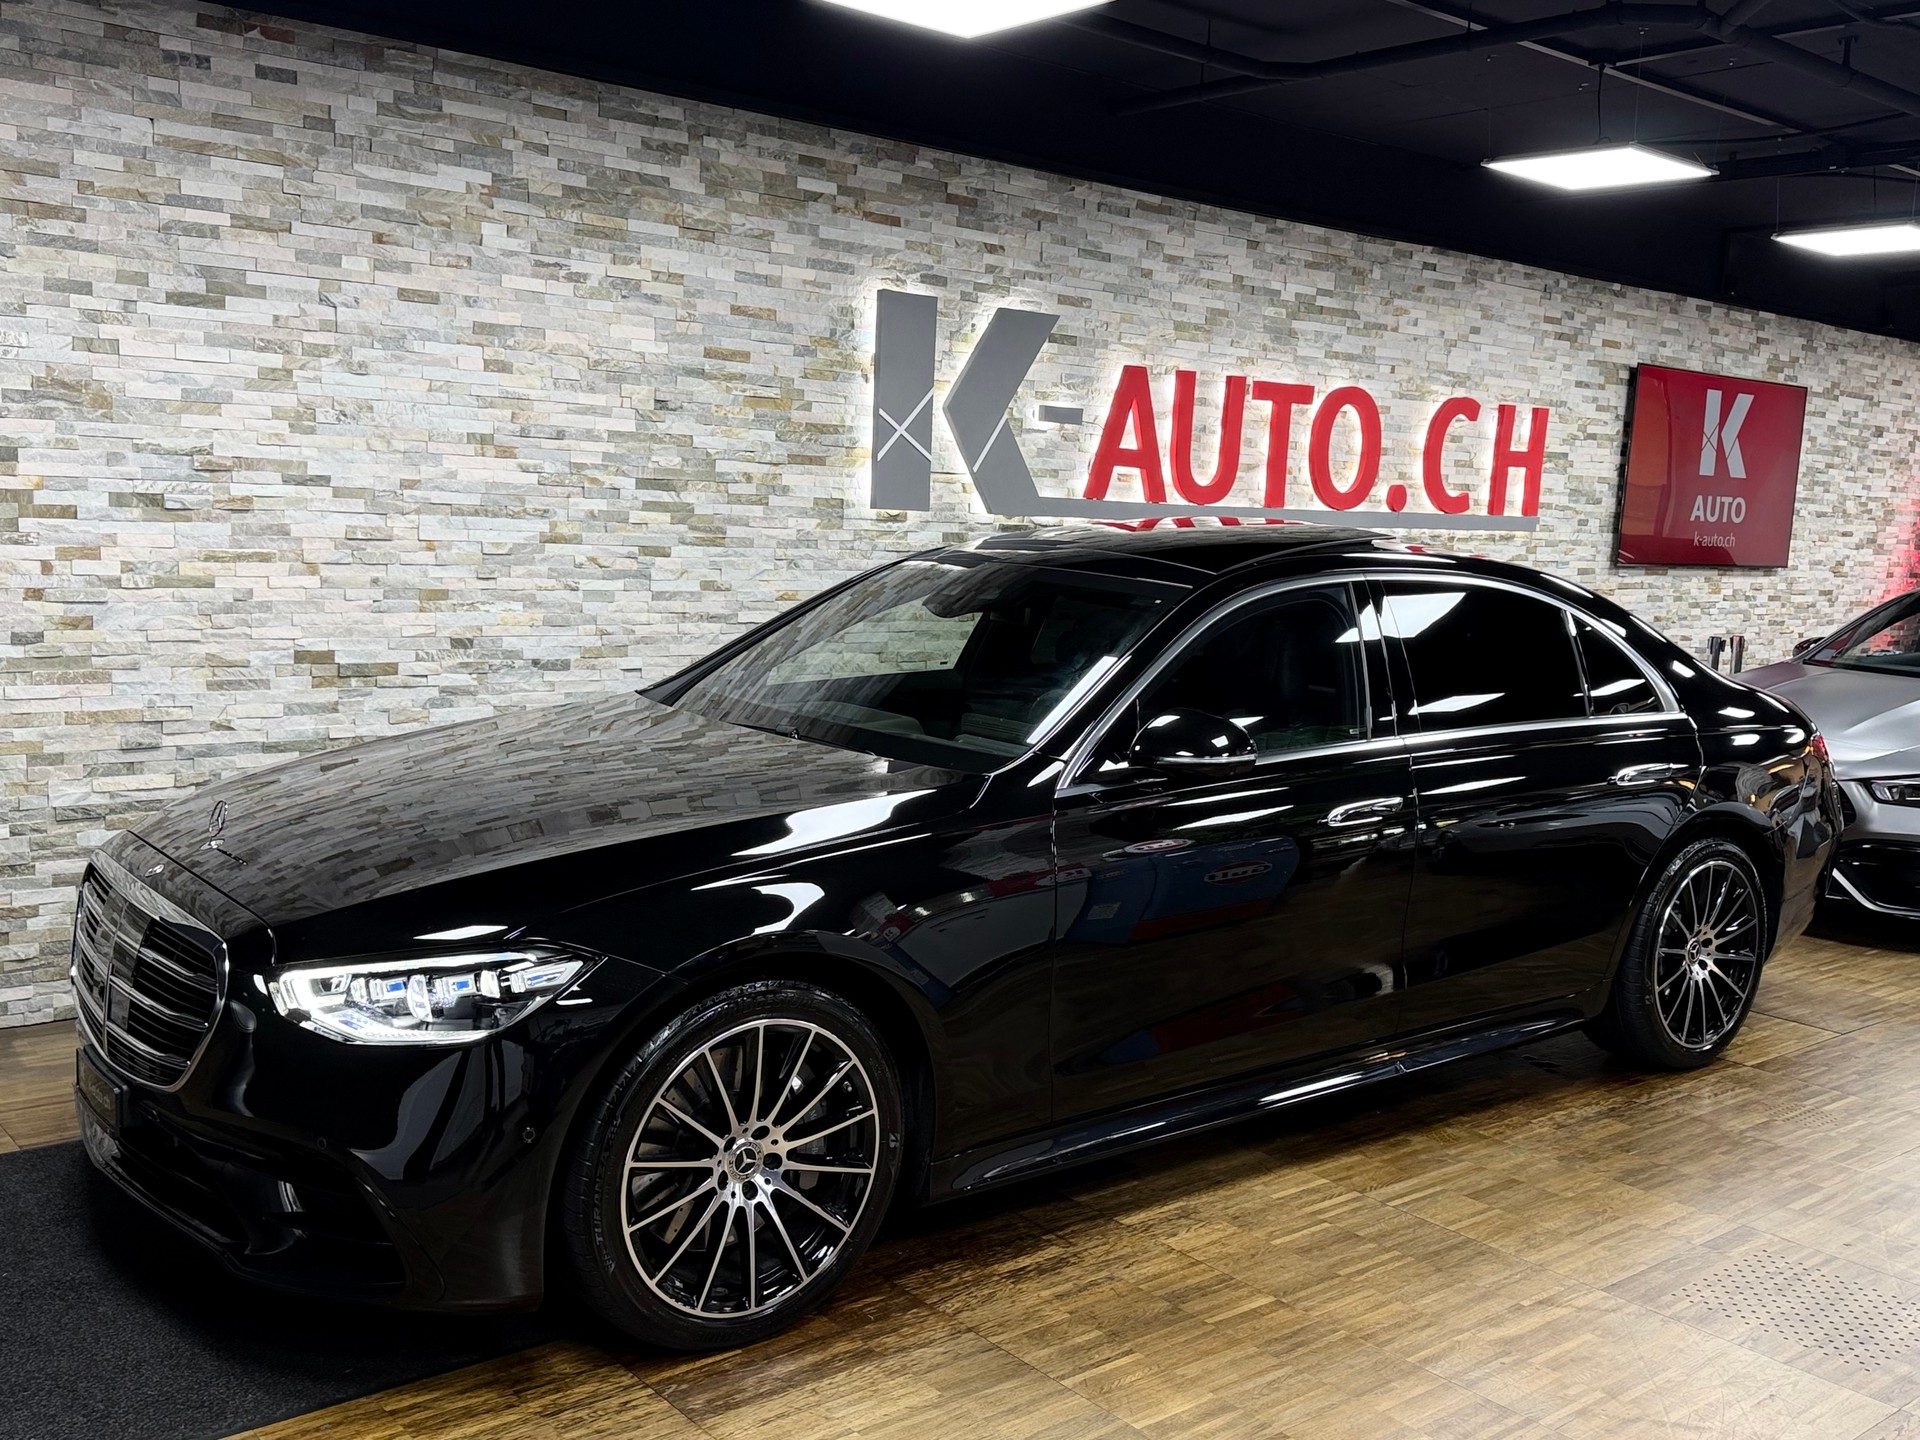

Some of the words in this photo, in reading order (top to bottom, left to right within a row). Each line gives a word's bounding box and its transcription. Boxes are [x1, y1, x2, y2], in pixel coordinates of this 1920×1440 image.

[1699, 389, 1755, 479] K
[1690, 495, 1747, 523] AUTO
[1693, 531, 1736, 547] k-auto.ch
